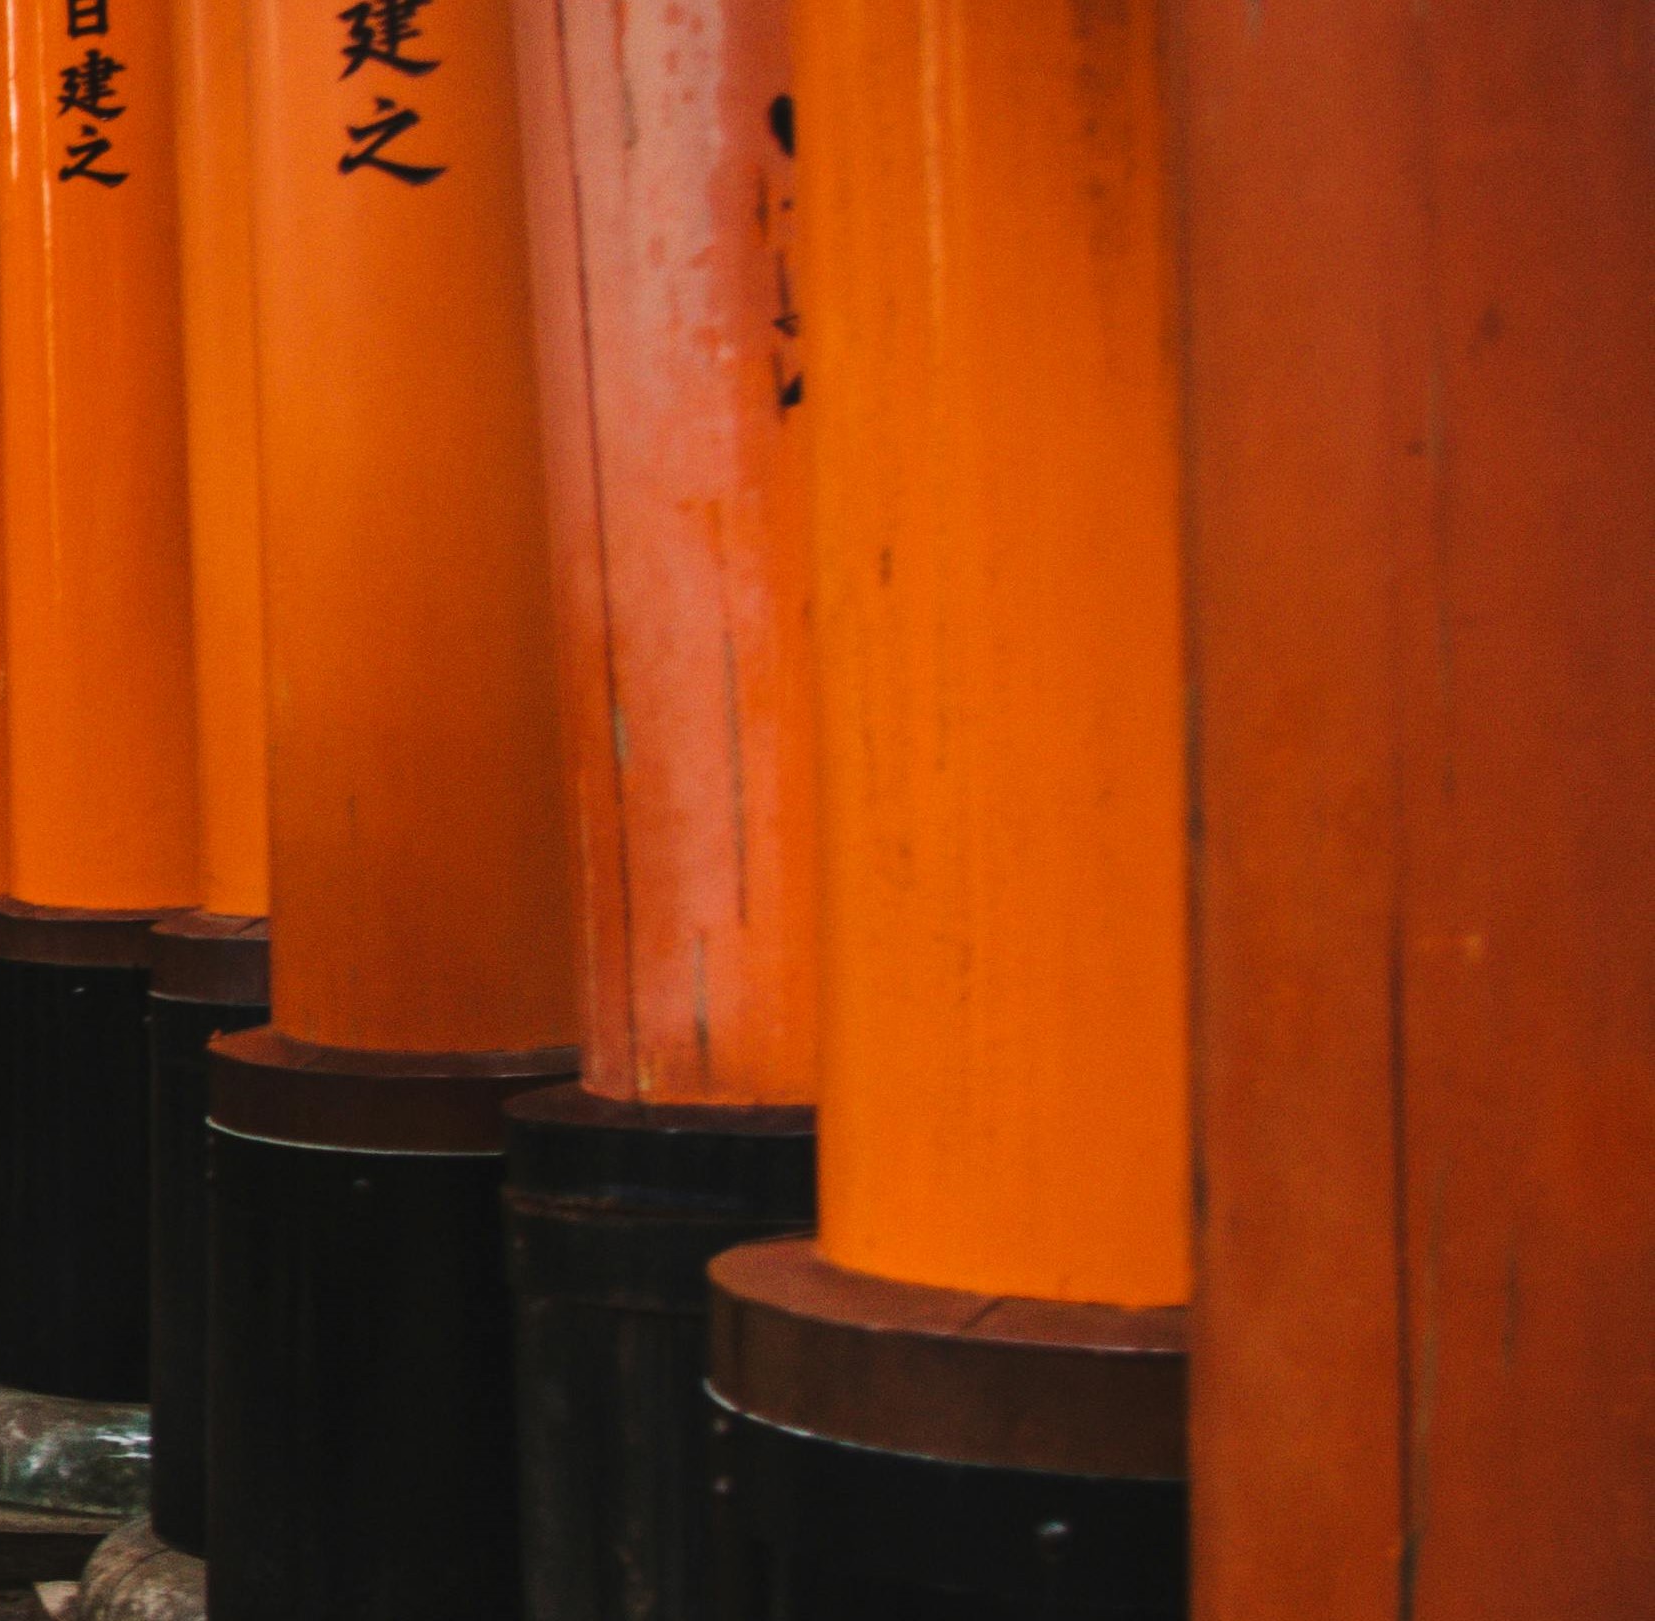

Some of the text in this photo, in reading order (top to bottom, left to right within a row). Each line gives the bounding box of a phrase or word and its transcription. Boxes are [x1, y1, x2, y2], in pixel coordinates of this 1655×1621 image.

[57, 0, 130, 188] 日建之
[337, 0, 449, 186] 建之
